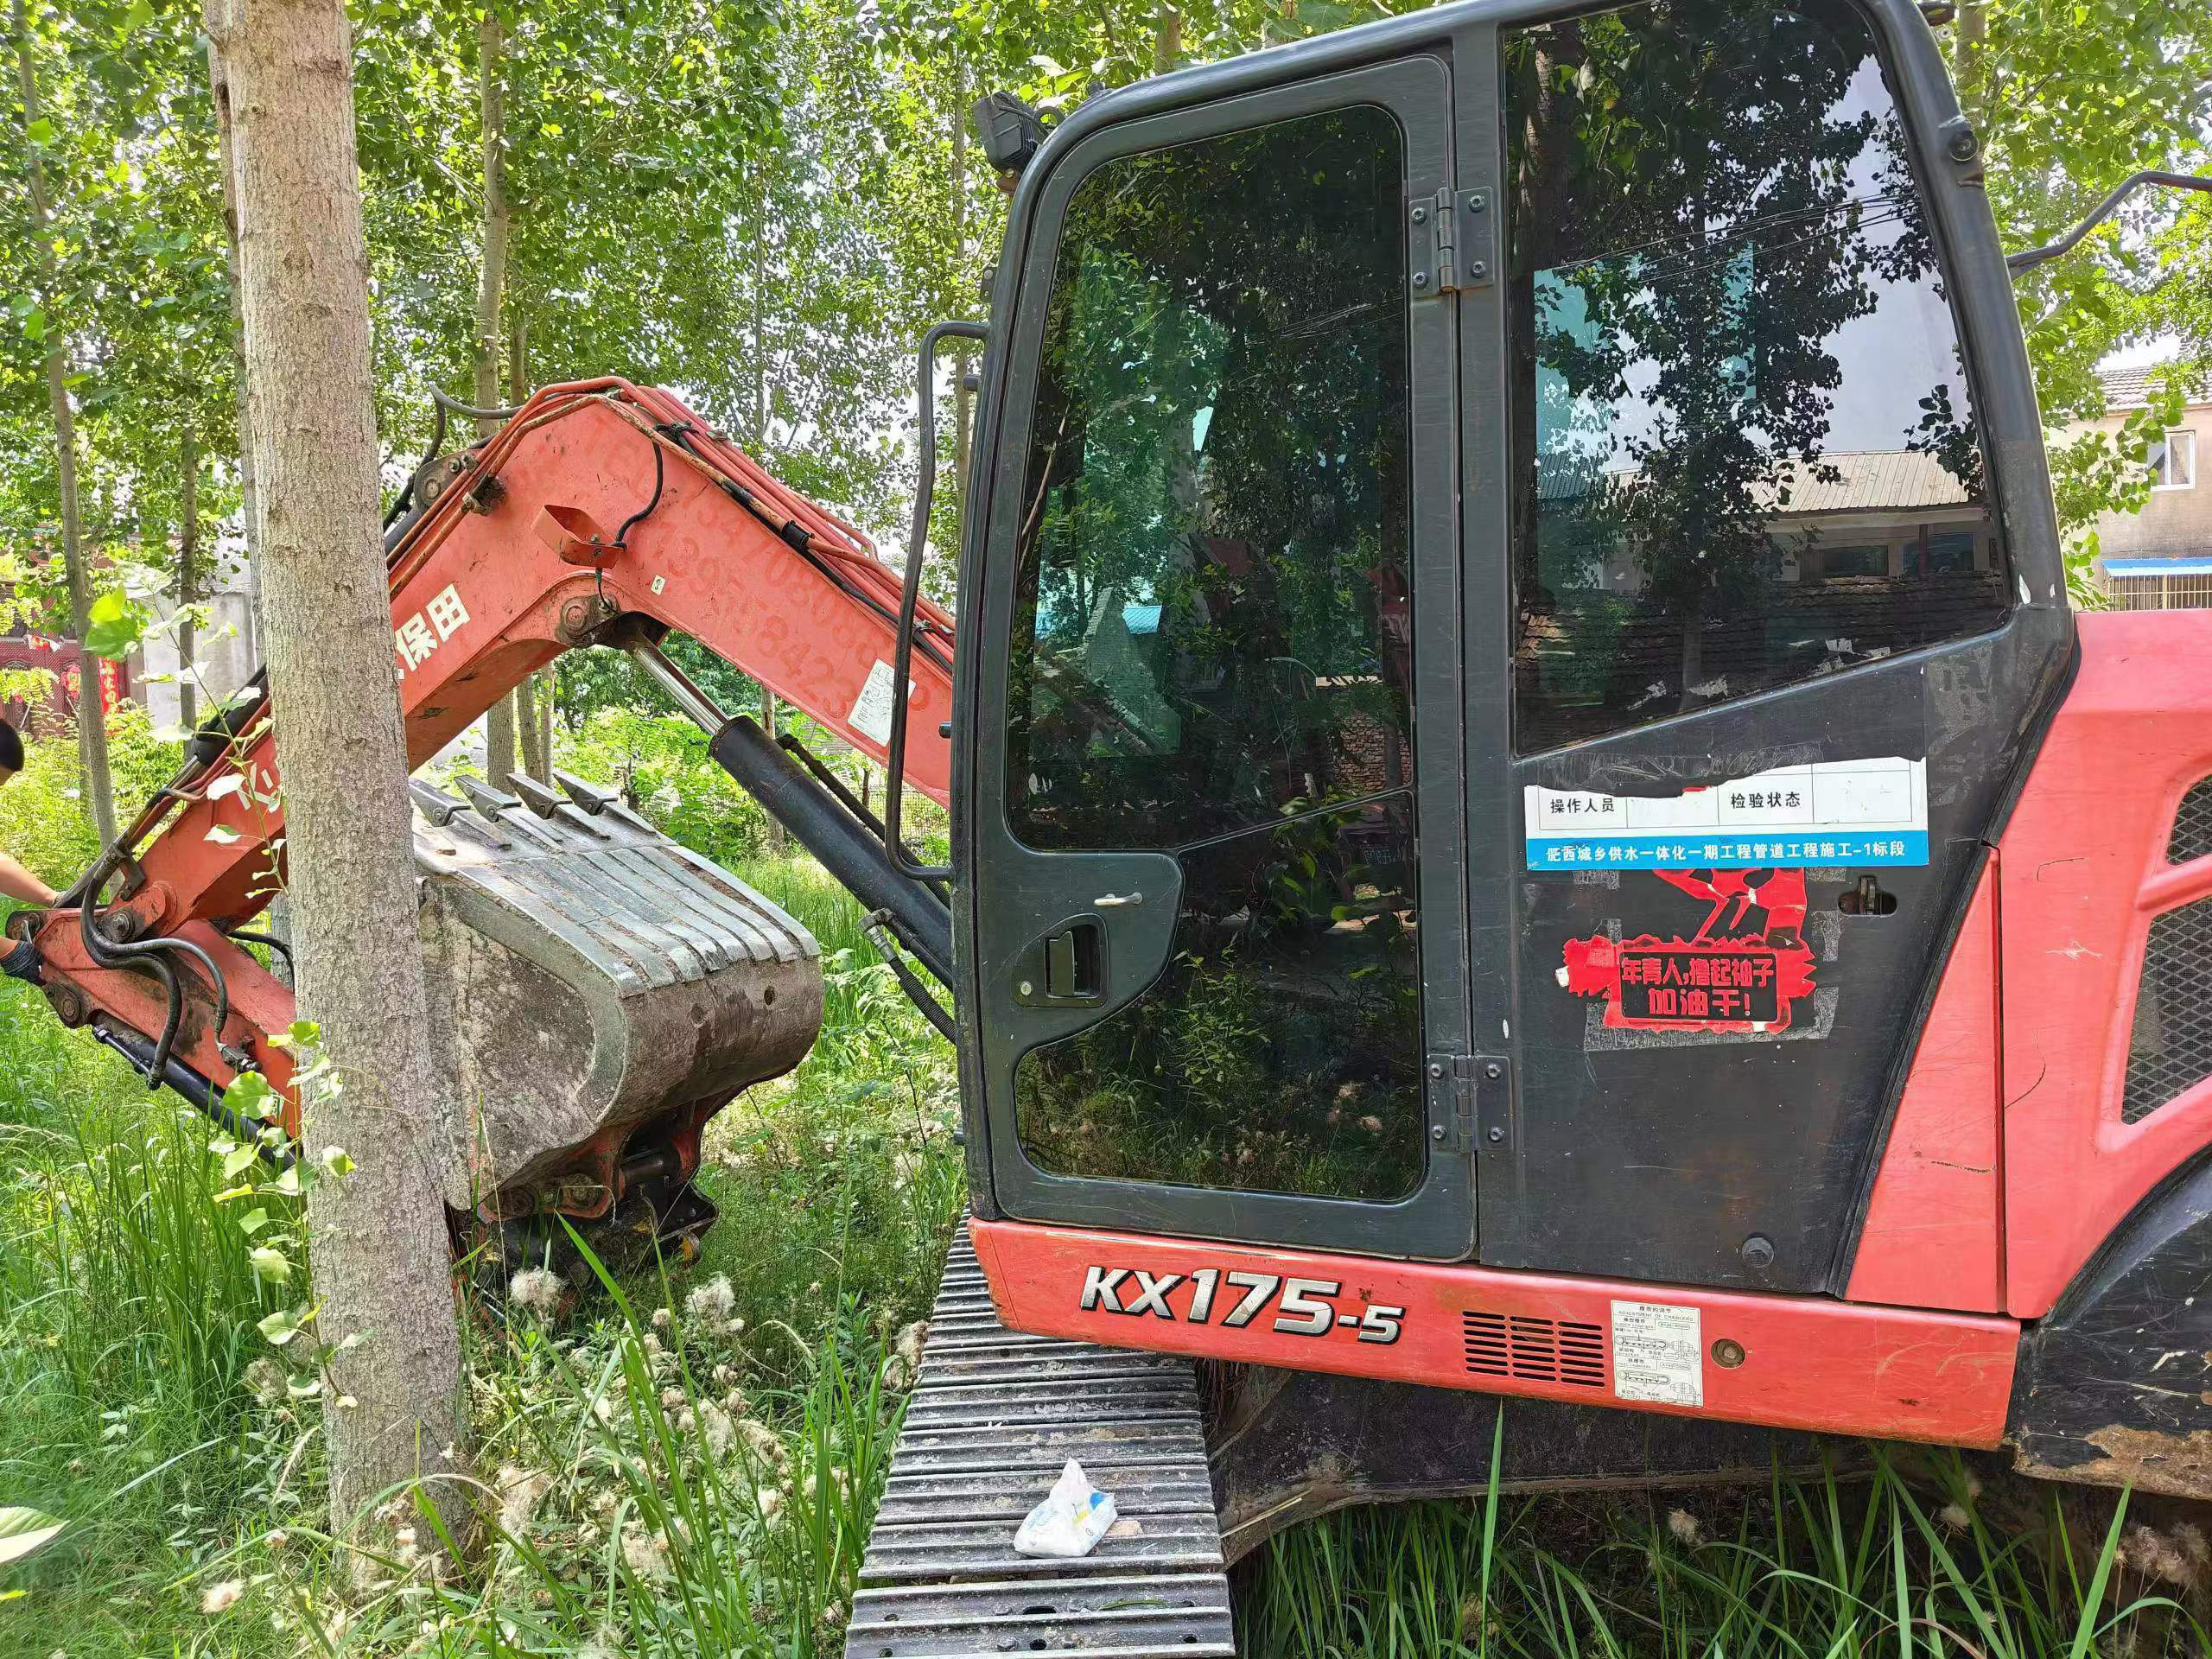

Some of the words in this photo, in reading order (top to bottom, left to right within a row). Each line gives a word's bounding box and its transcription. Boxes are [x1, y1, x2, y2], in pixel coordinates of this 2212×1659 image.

[395, 583, 470, 679] 保田
[1549, 798, 1616, 815] 操作人员
[1730, 791, 1802, 810] 检验状态
[1080, 1265, 1406, 1345] KX175-5
